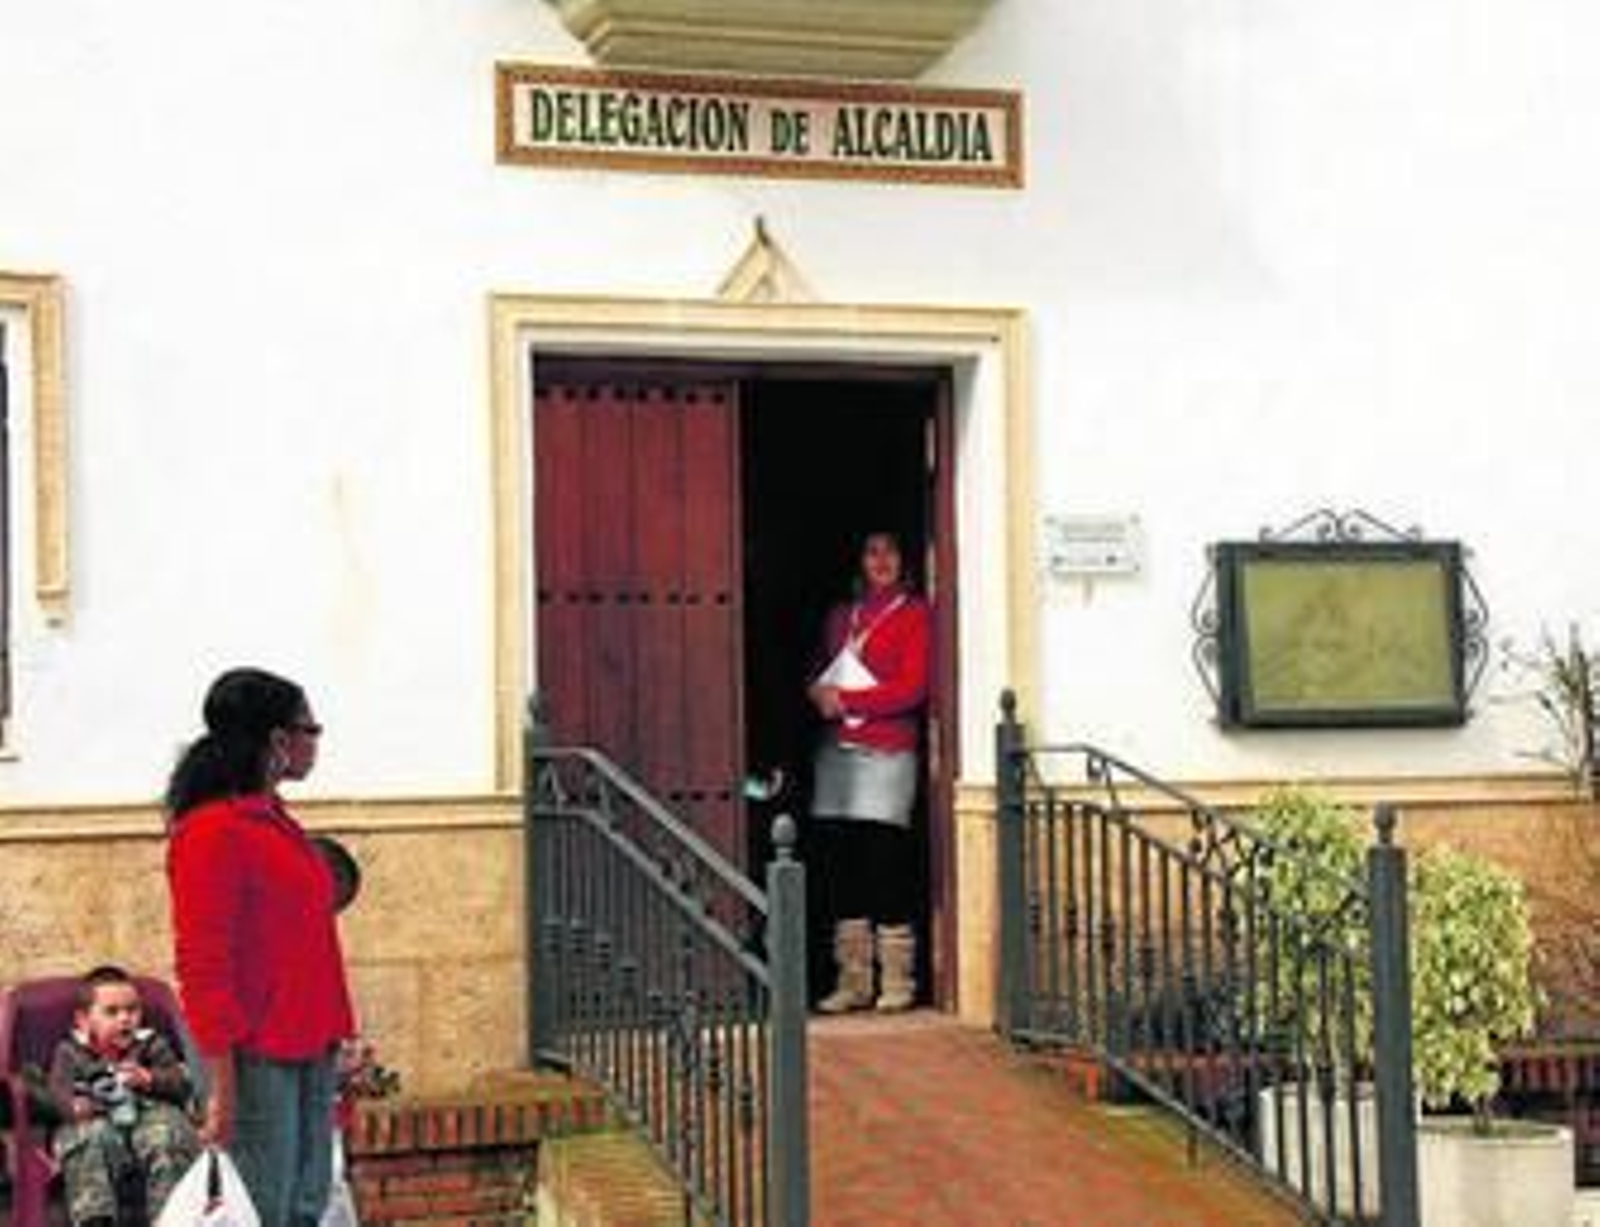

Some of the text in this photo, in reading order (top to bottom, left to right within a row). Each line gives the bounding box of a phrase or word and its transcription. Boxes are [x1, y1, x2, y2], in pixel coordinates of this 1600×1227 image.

[531, 88, 992, 161] DELEGACION DE ALCALDIA
